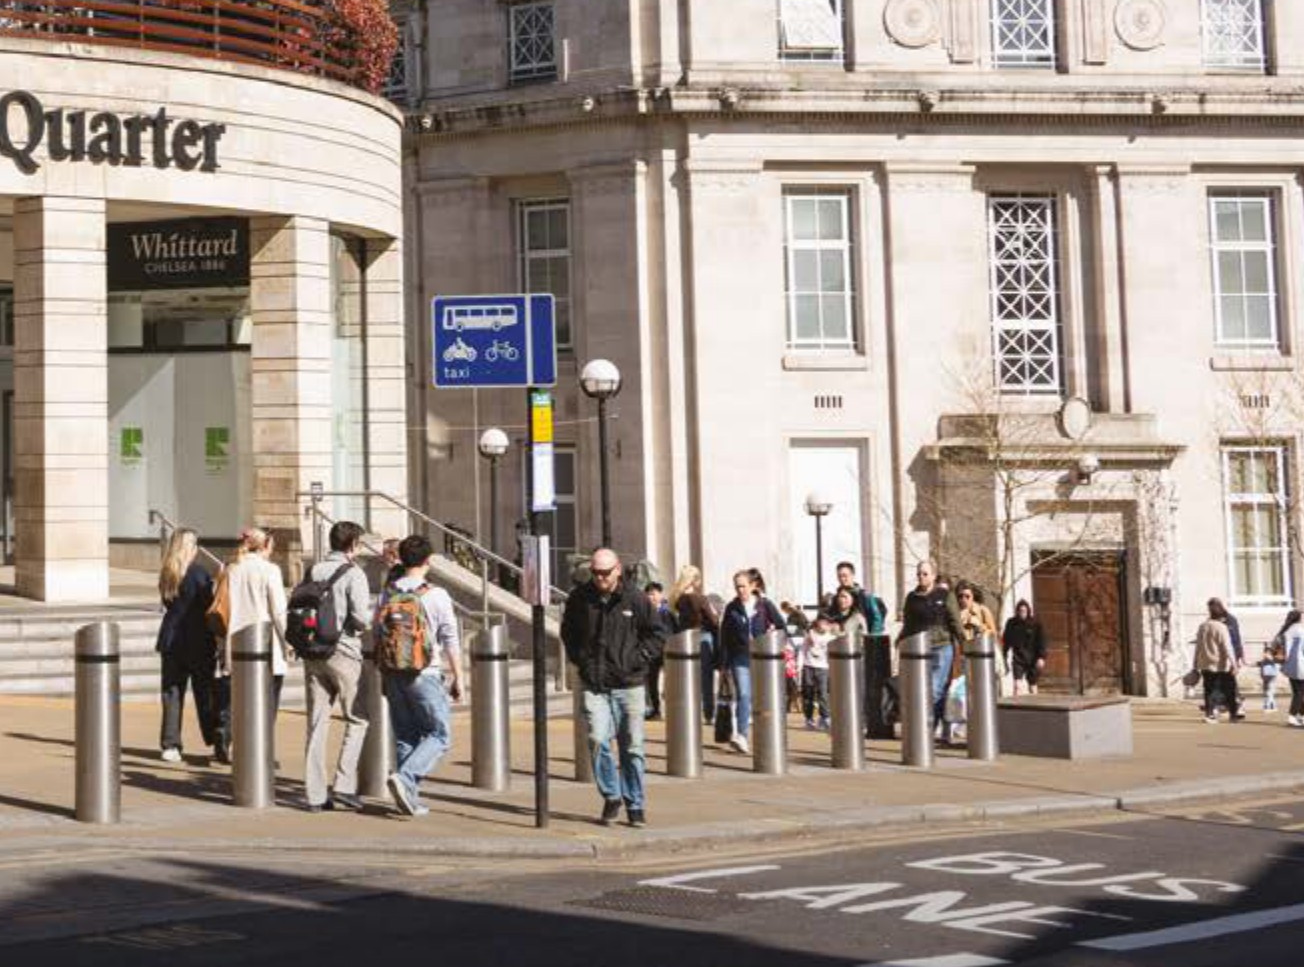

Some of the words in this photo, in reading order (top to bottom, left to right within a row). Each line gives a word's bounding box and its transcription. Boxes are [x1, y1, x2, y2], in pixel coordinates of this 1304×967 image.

[129, 229, 238, 260] Whittard
[145, 261, 196, 274] CHELSEA
[444, 367, 470, 378] taxi
[906, 851, 1246, 901] BUS
[638, 864, 1132, 939] LANE
